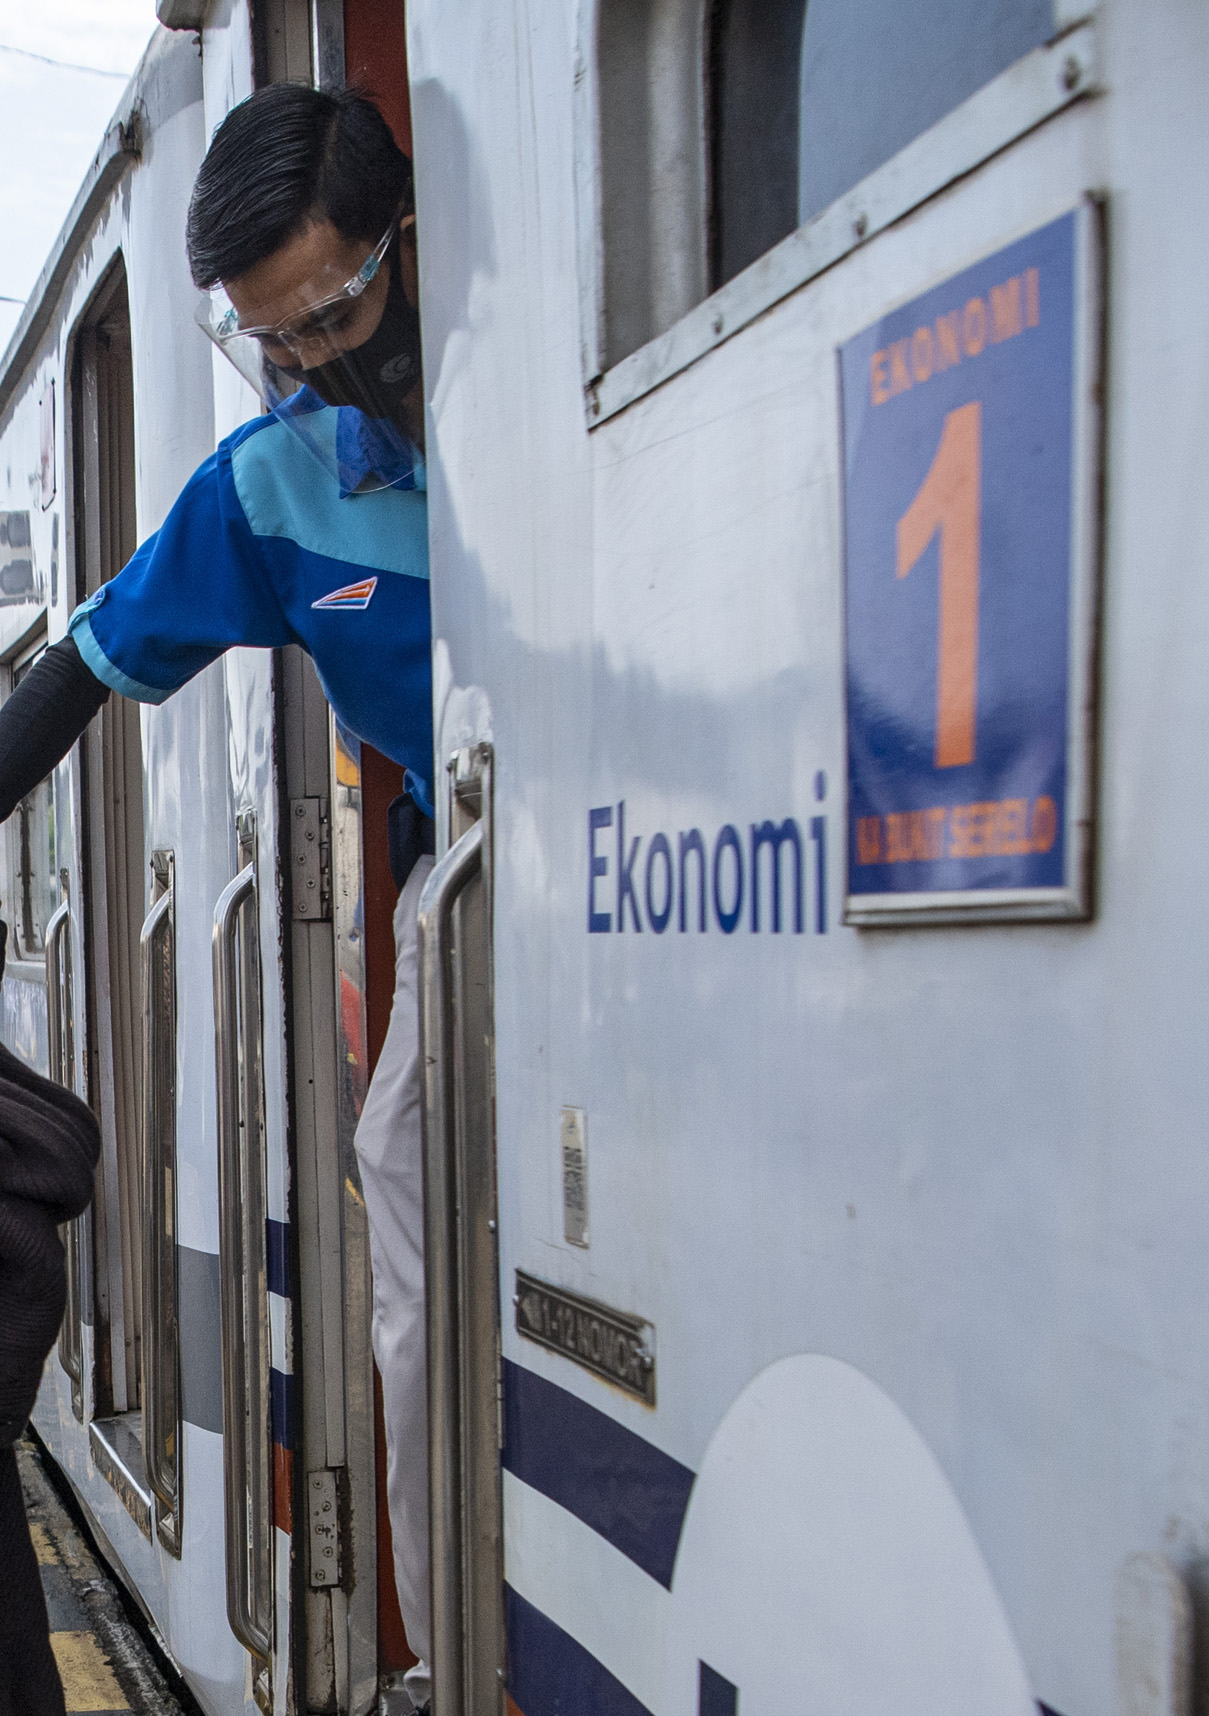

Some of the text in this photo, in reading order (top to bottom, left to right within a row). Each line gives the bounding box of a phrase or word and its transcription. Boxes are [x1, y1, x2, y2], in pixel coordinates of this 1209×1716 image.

[869, 266, 1040, 407] EKONOMI
[895, 400, 982, 769] 1
[588, 769, 827, 934] Ekonomi
